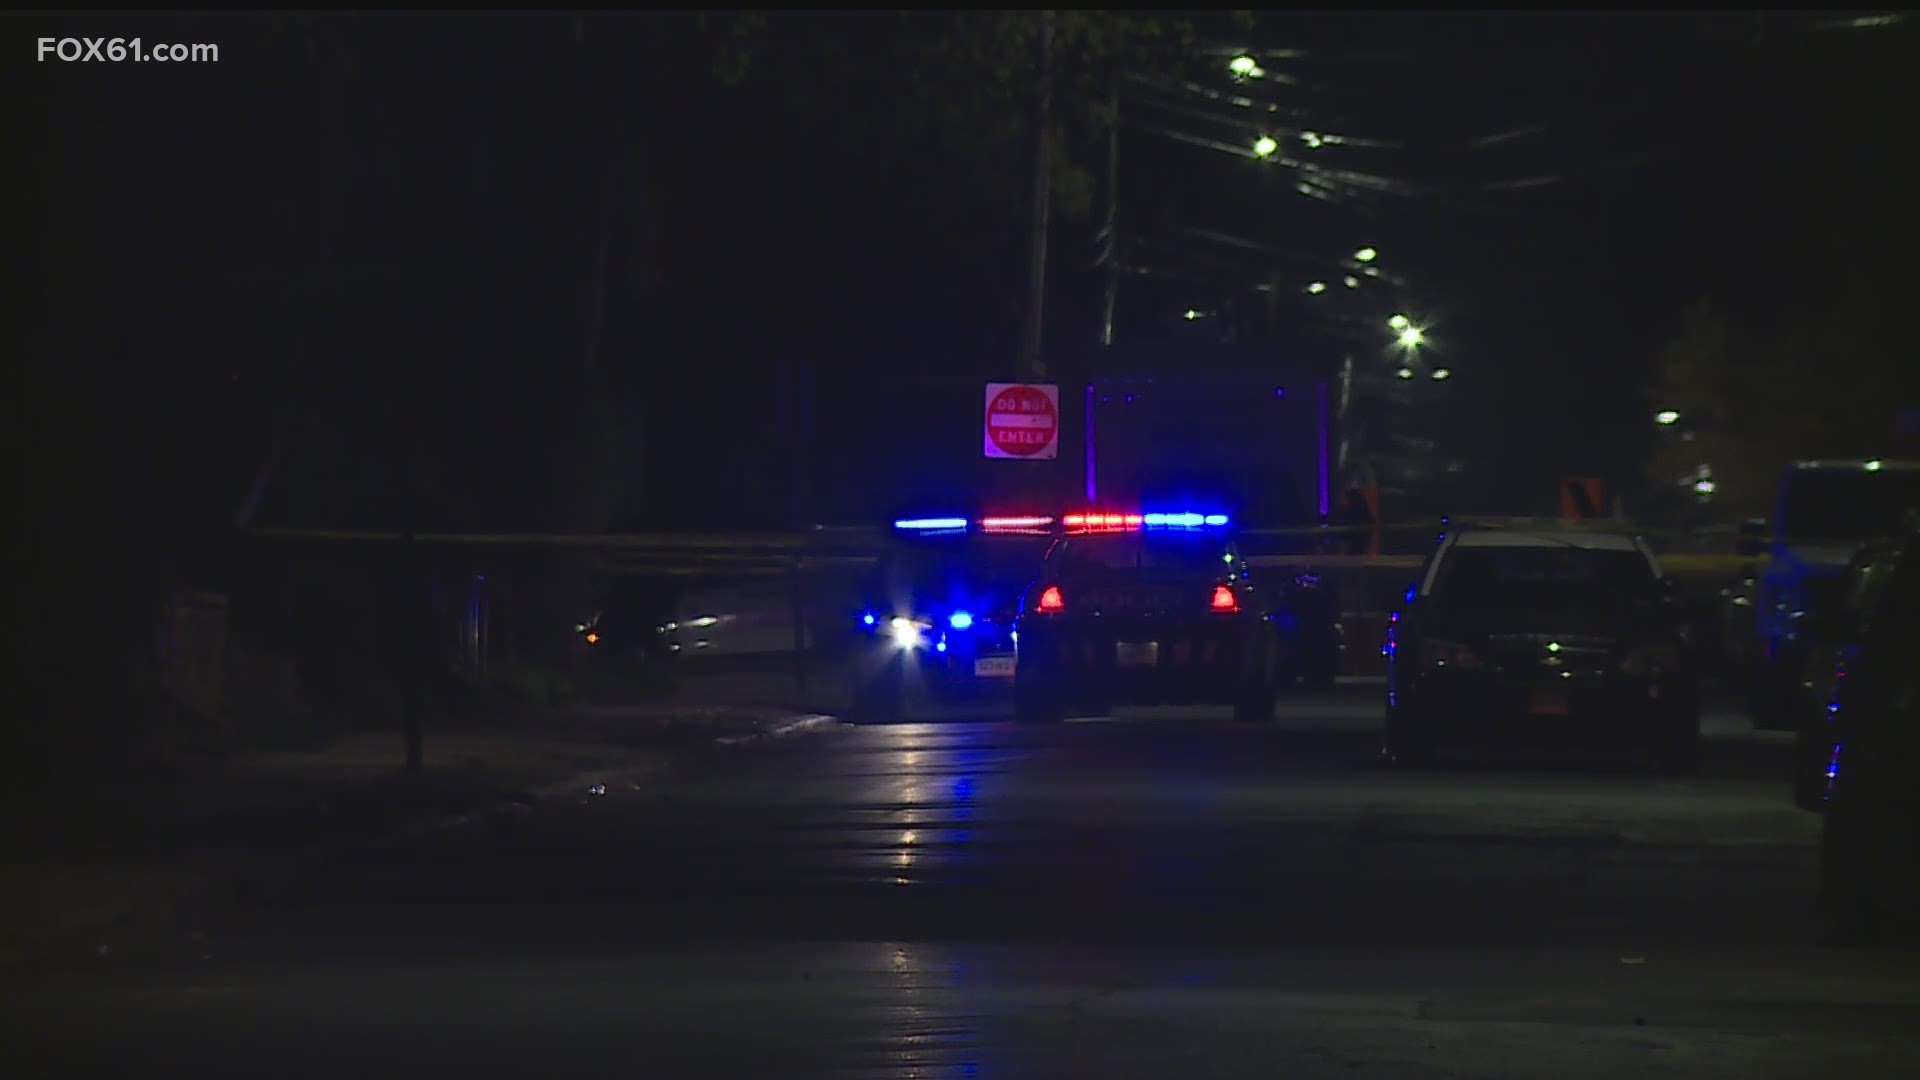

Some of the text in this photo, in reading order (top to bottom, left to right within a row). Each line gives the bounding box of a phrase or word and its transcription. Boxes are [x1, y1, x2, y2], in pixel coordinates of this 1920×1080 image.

[997, 398, 1047, 412] DO NOT
[998, 431, 1044, 444] ENTER
